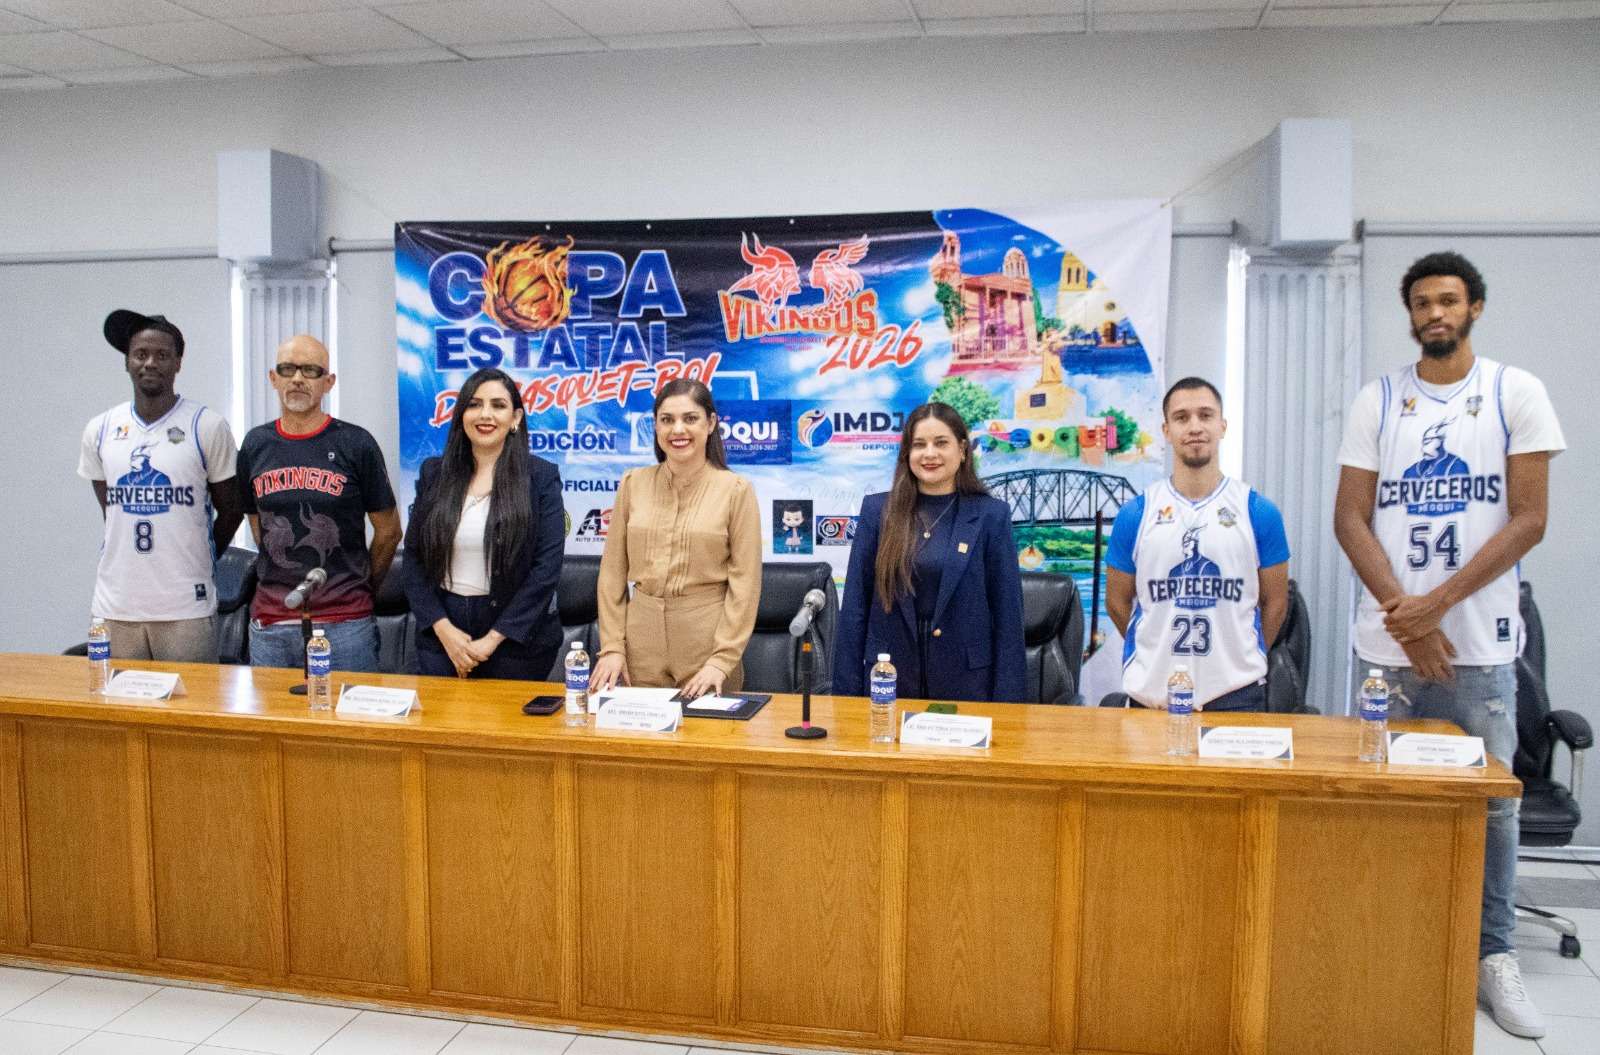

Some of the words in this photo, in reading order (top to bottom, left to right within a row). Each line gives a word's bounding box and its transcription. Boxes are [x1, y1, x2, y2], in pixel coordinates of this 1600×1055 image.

[718, 289, 878, 343] VIKINGOS
[434, 322, 686, 372] ESTATAL
[819, 320, 923, 376] 2026
[429, 391, 459, 428] D
[512, 352, 722, 415] ASQUET-BOL
[719, 421, 778, 444] OQUI
[106, 486, 195, 507] CERVECEROS
[253, 466, 347, 498] VIKINGOS
[1378, 475, 1501, 508] CERVECEROS
[136, 520, 153, 553] 8
[1407, 522, 1460, 571] 54
[1147, 577, 1244, 602] CERVECEROS
[1171, 615, 1211, 656] 23
